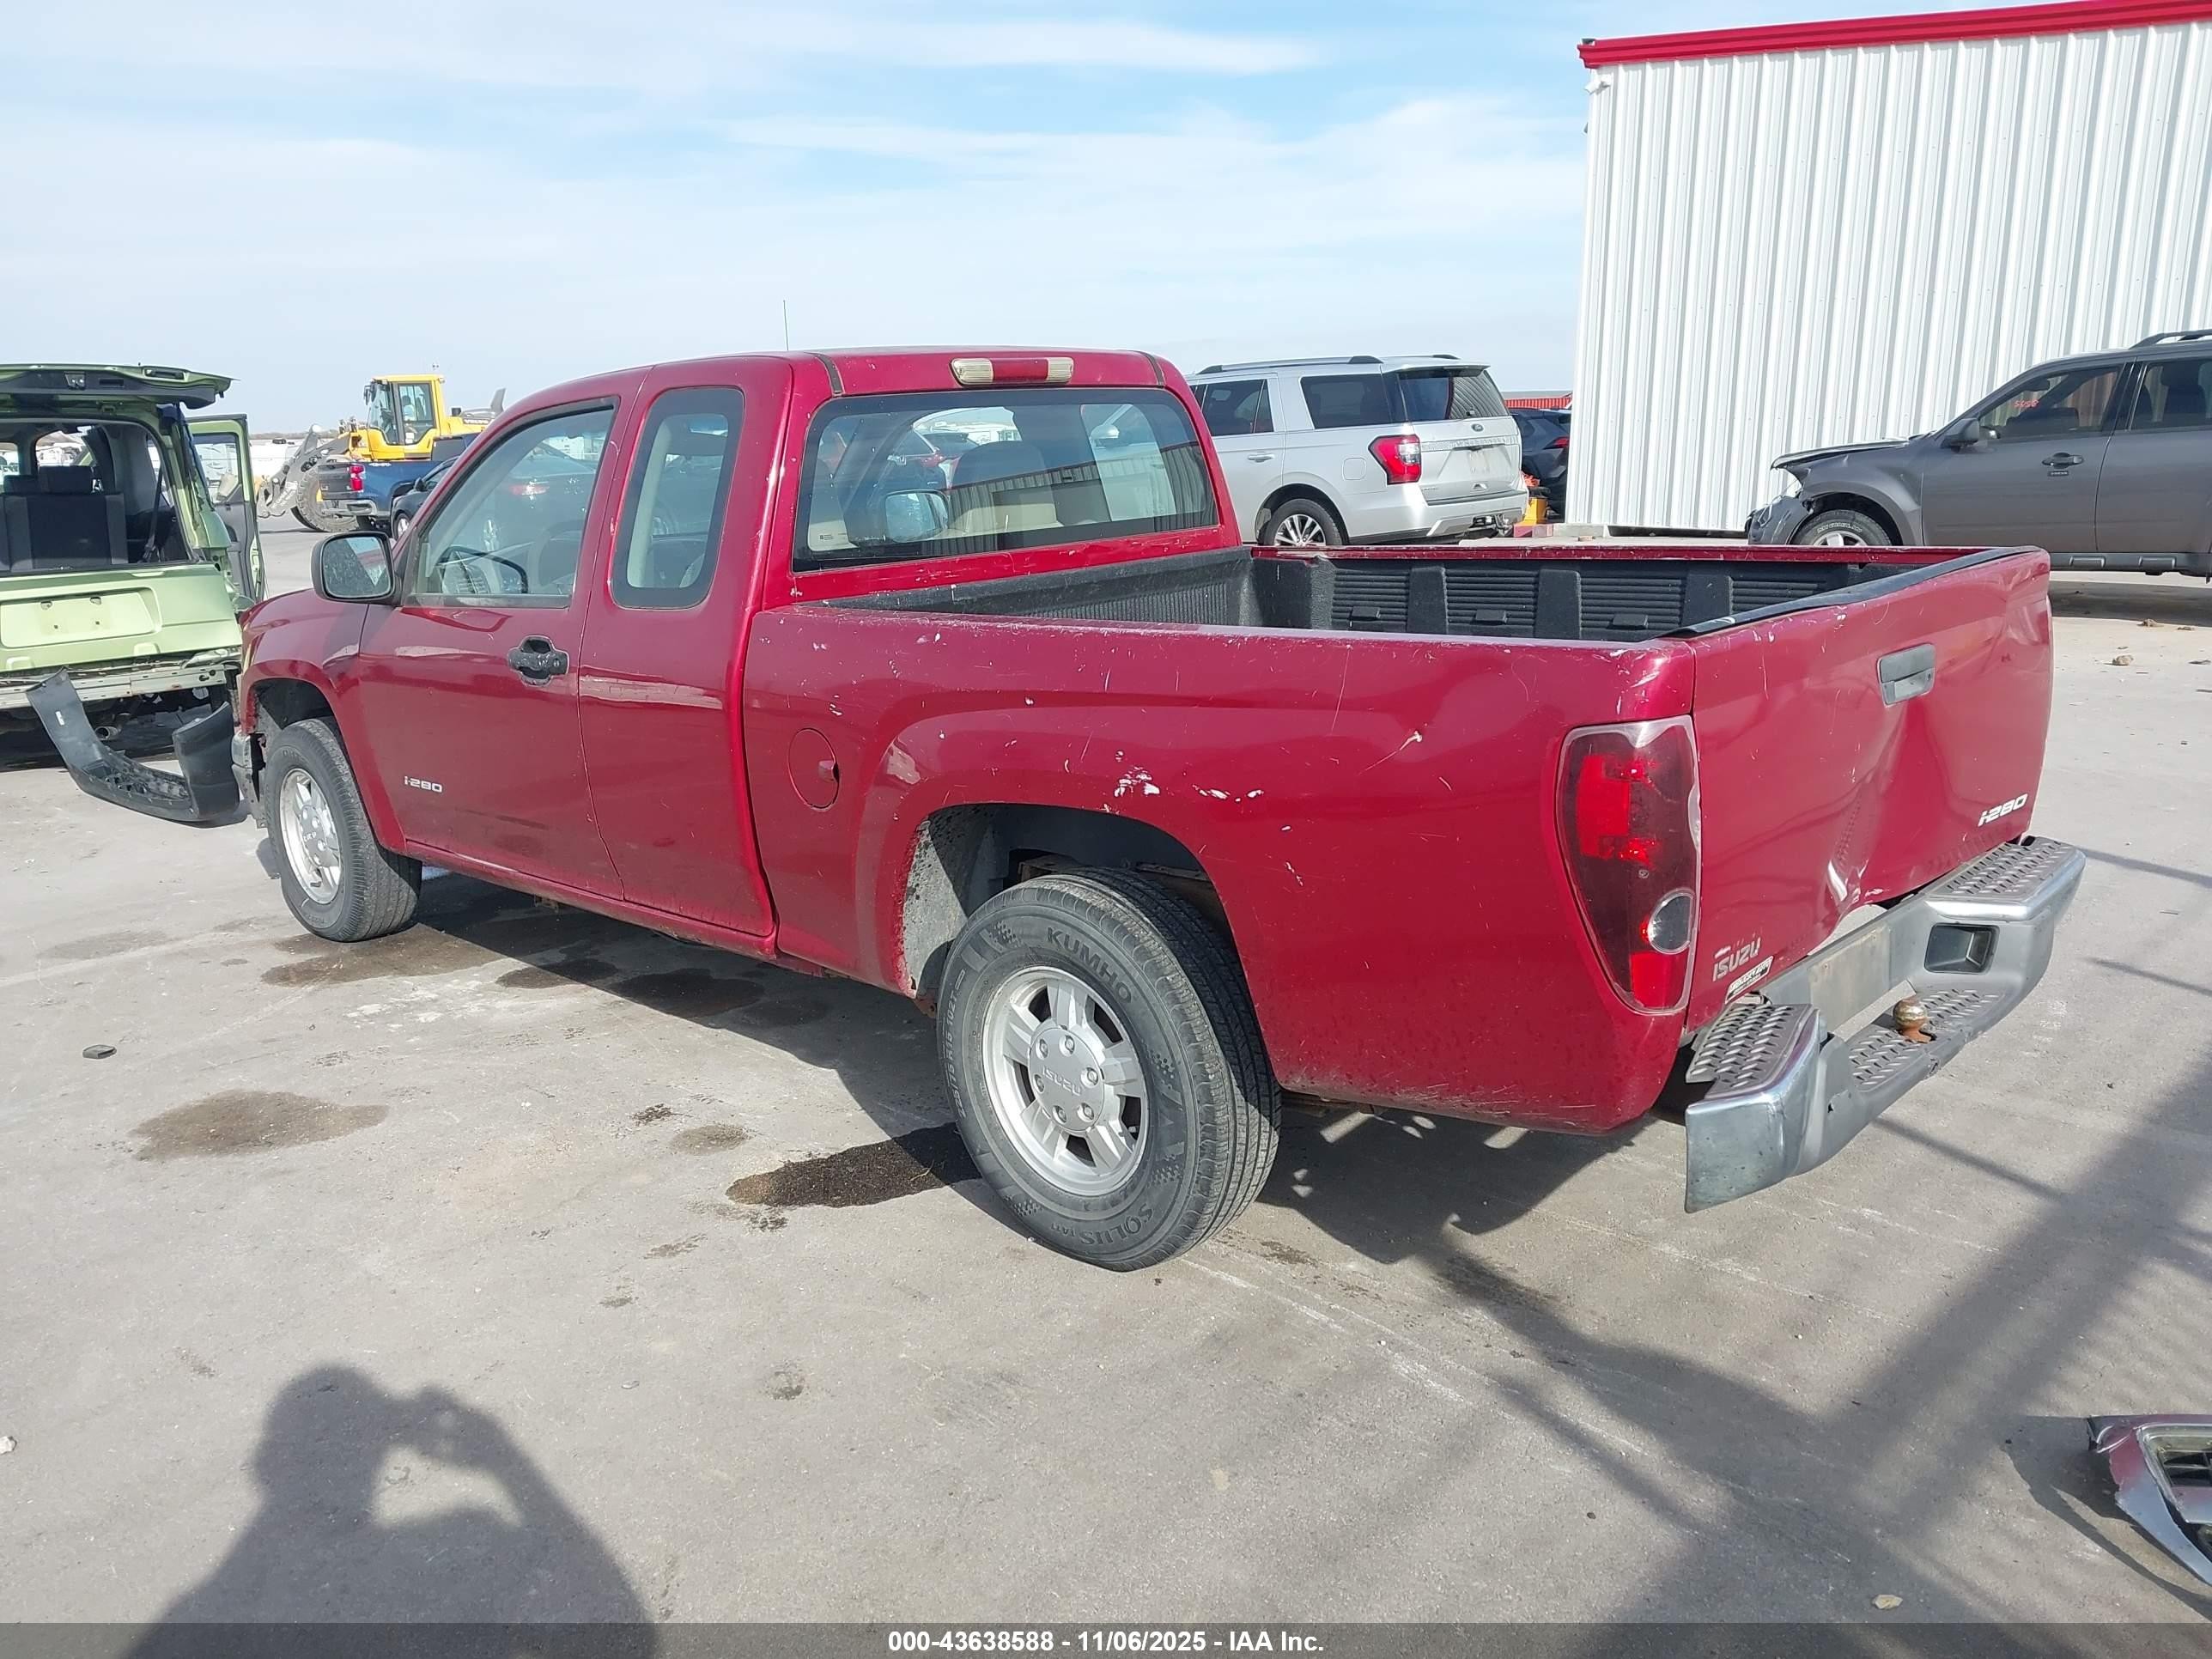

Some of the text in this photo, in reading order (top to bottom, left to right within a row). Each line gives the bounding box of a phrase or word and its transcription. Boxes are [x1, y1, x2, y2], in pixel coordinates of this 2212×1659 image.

[1047, 927, 1132, 1004] KUMHO
[1712, 937, 1761, 981] ISUZU
[1042, 1065, 1081, 1097] ISUZU
[1079, 1202, 1153, 1245] SOLUS
